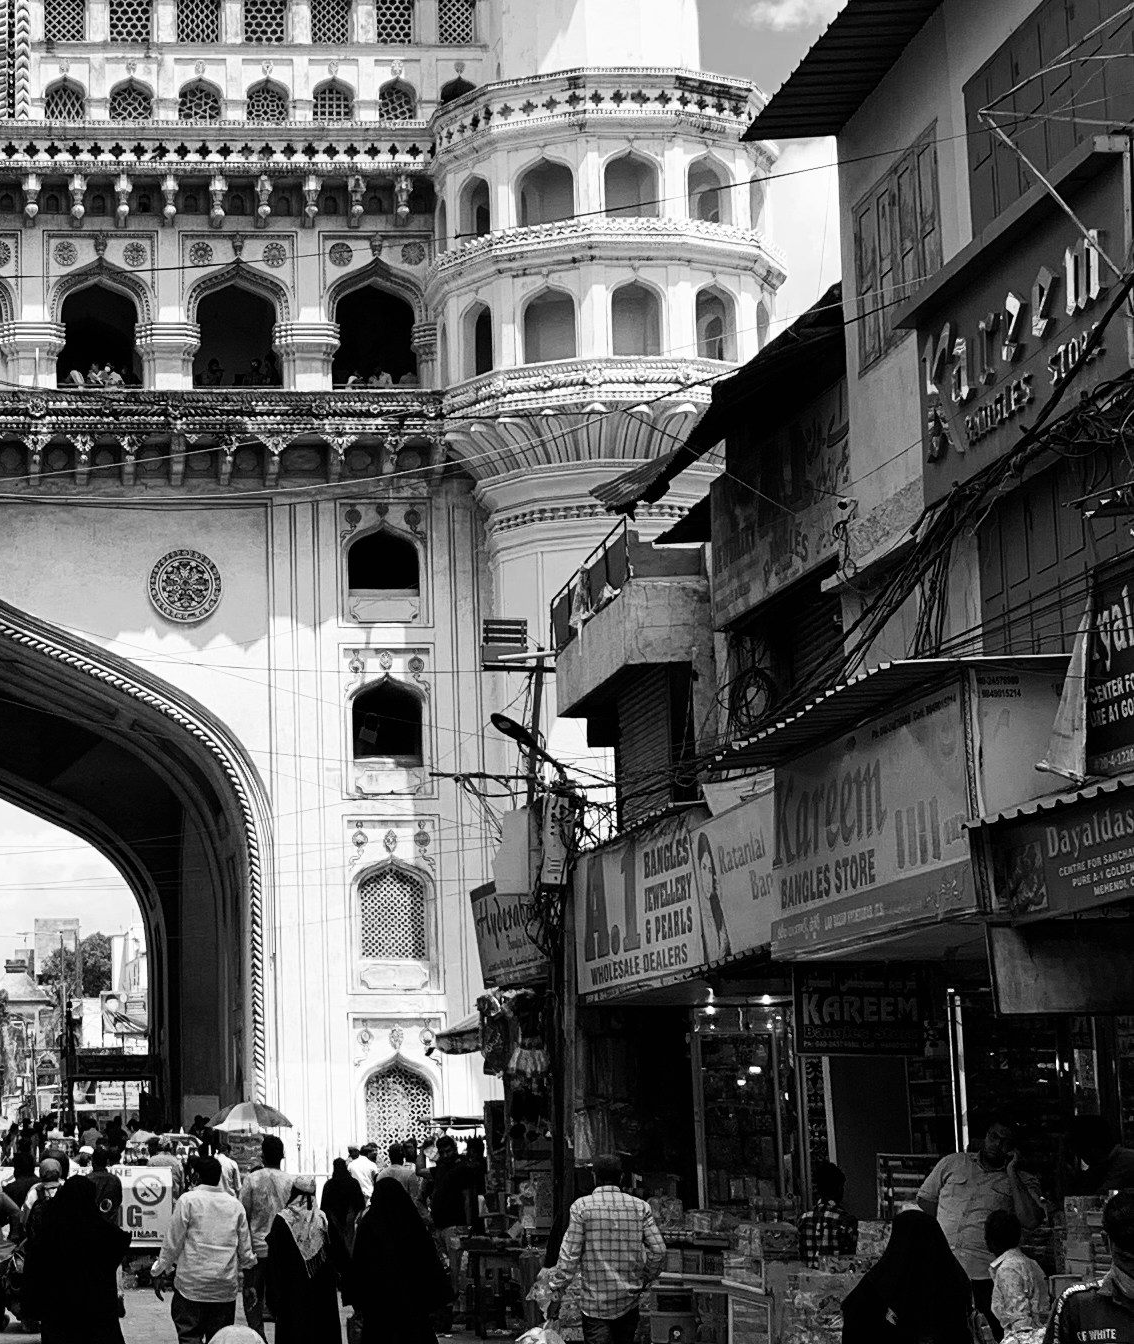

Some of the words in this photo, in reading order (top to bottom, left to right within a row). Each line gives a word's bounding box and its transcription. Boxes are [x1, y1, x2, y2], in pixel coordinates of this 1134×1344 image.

[1089, 674, 1123, 705] CENTER
[1108, 704, 1120, 724] A1
[772, 758, 888, 870] Kareem
[1045, 807, 1134, 858] Dayaldas
[643, 835, 691, 880] BANGLES
[717, 824, 766, 876] Ratanlal
[1058, 859, 1086, 878] CENTRE
[1087, 856, 1102, 869] FOR
[644, 871, 693, 914] JEWELLERY
[780, 862, 831, 911] BANGLES
[834, 848, 876, 894] STORE
[1072, 874, 1092, 888] PURE
[645, 918, 652, 945] &
[654, 905, 694, 943] PEARLS
[590, 957, 641, 987] WHOLESALE
[642, 942, 689, 973] DEALERS
[802, 993, 919, 1025] KAREEM
[1088, 1328, 1117, 1341] WHITE
